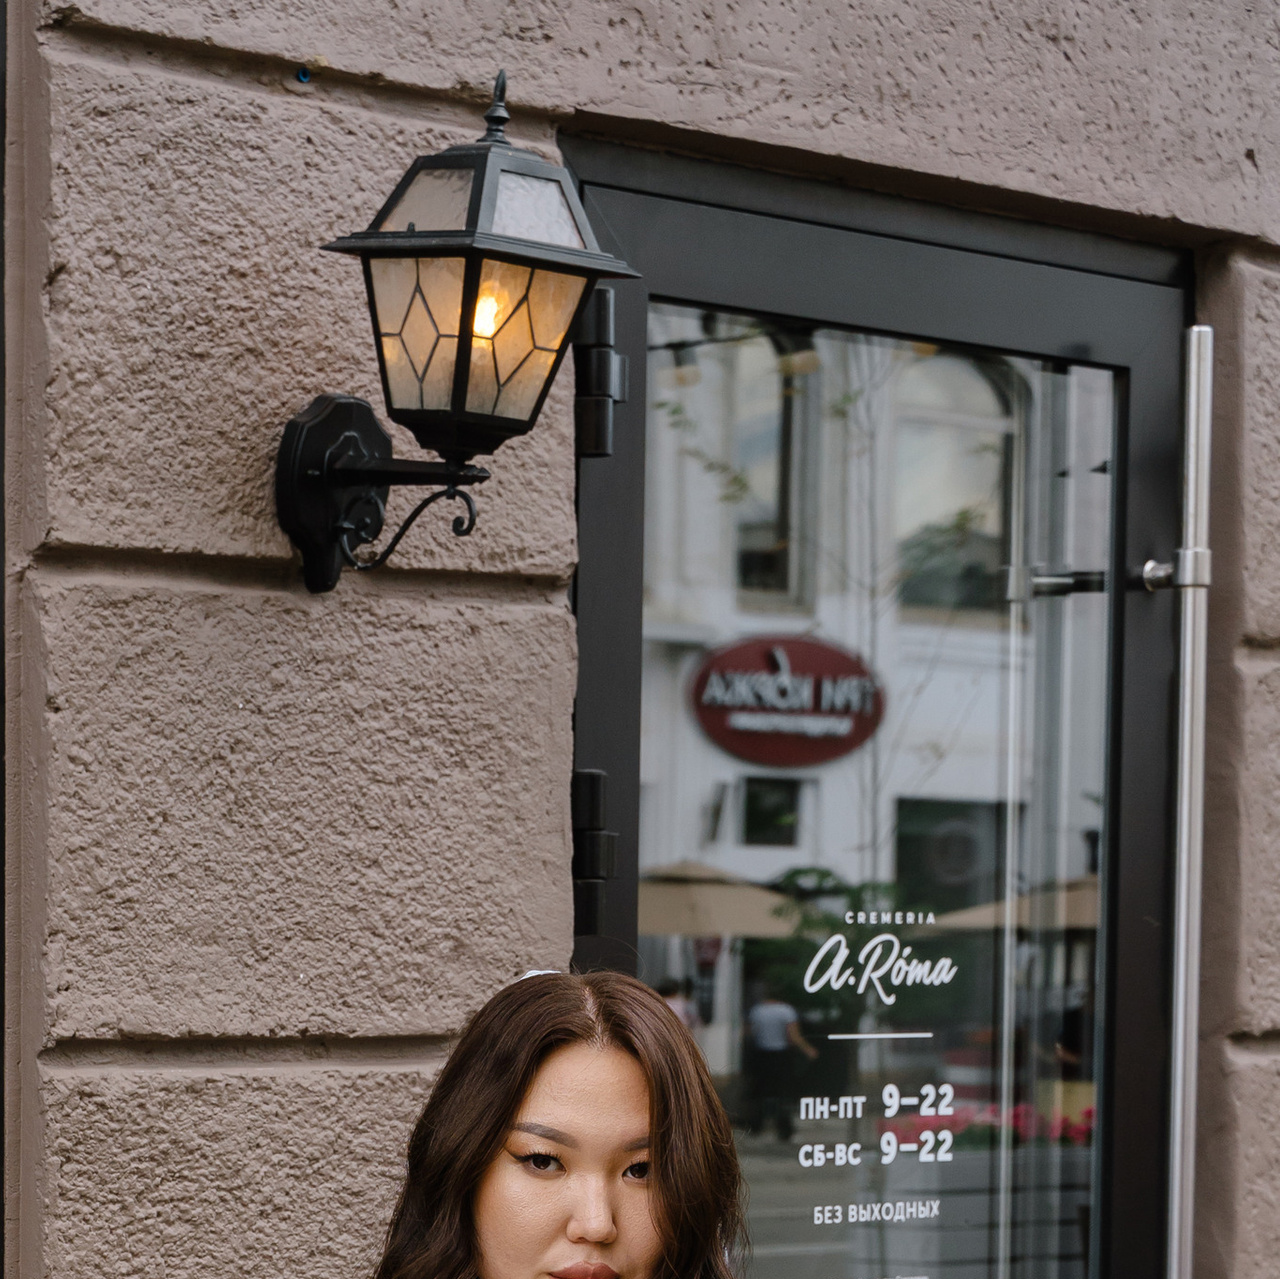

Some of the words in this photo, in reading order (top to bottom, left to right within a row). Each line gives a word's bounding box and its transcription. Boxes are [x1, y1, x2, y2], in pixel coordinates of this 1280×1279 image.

[845, 911, 936, 925] CREMERIA
[799, 1095, 867, 1120] ПН-ПТ
[798, 1142, 862, 1168] СБ-ВС
[813, 1205, 843, 1225] БЕЗ
[848, 1200, 941, 1223] ВЫХОДНЫХ
